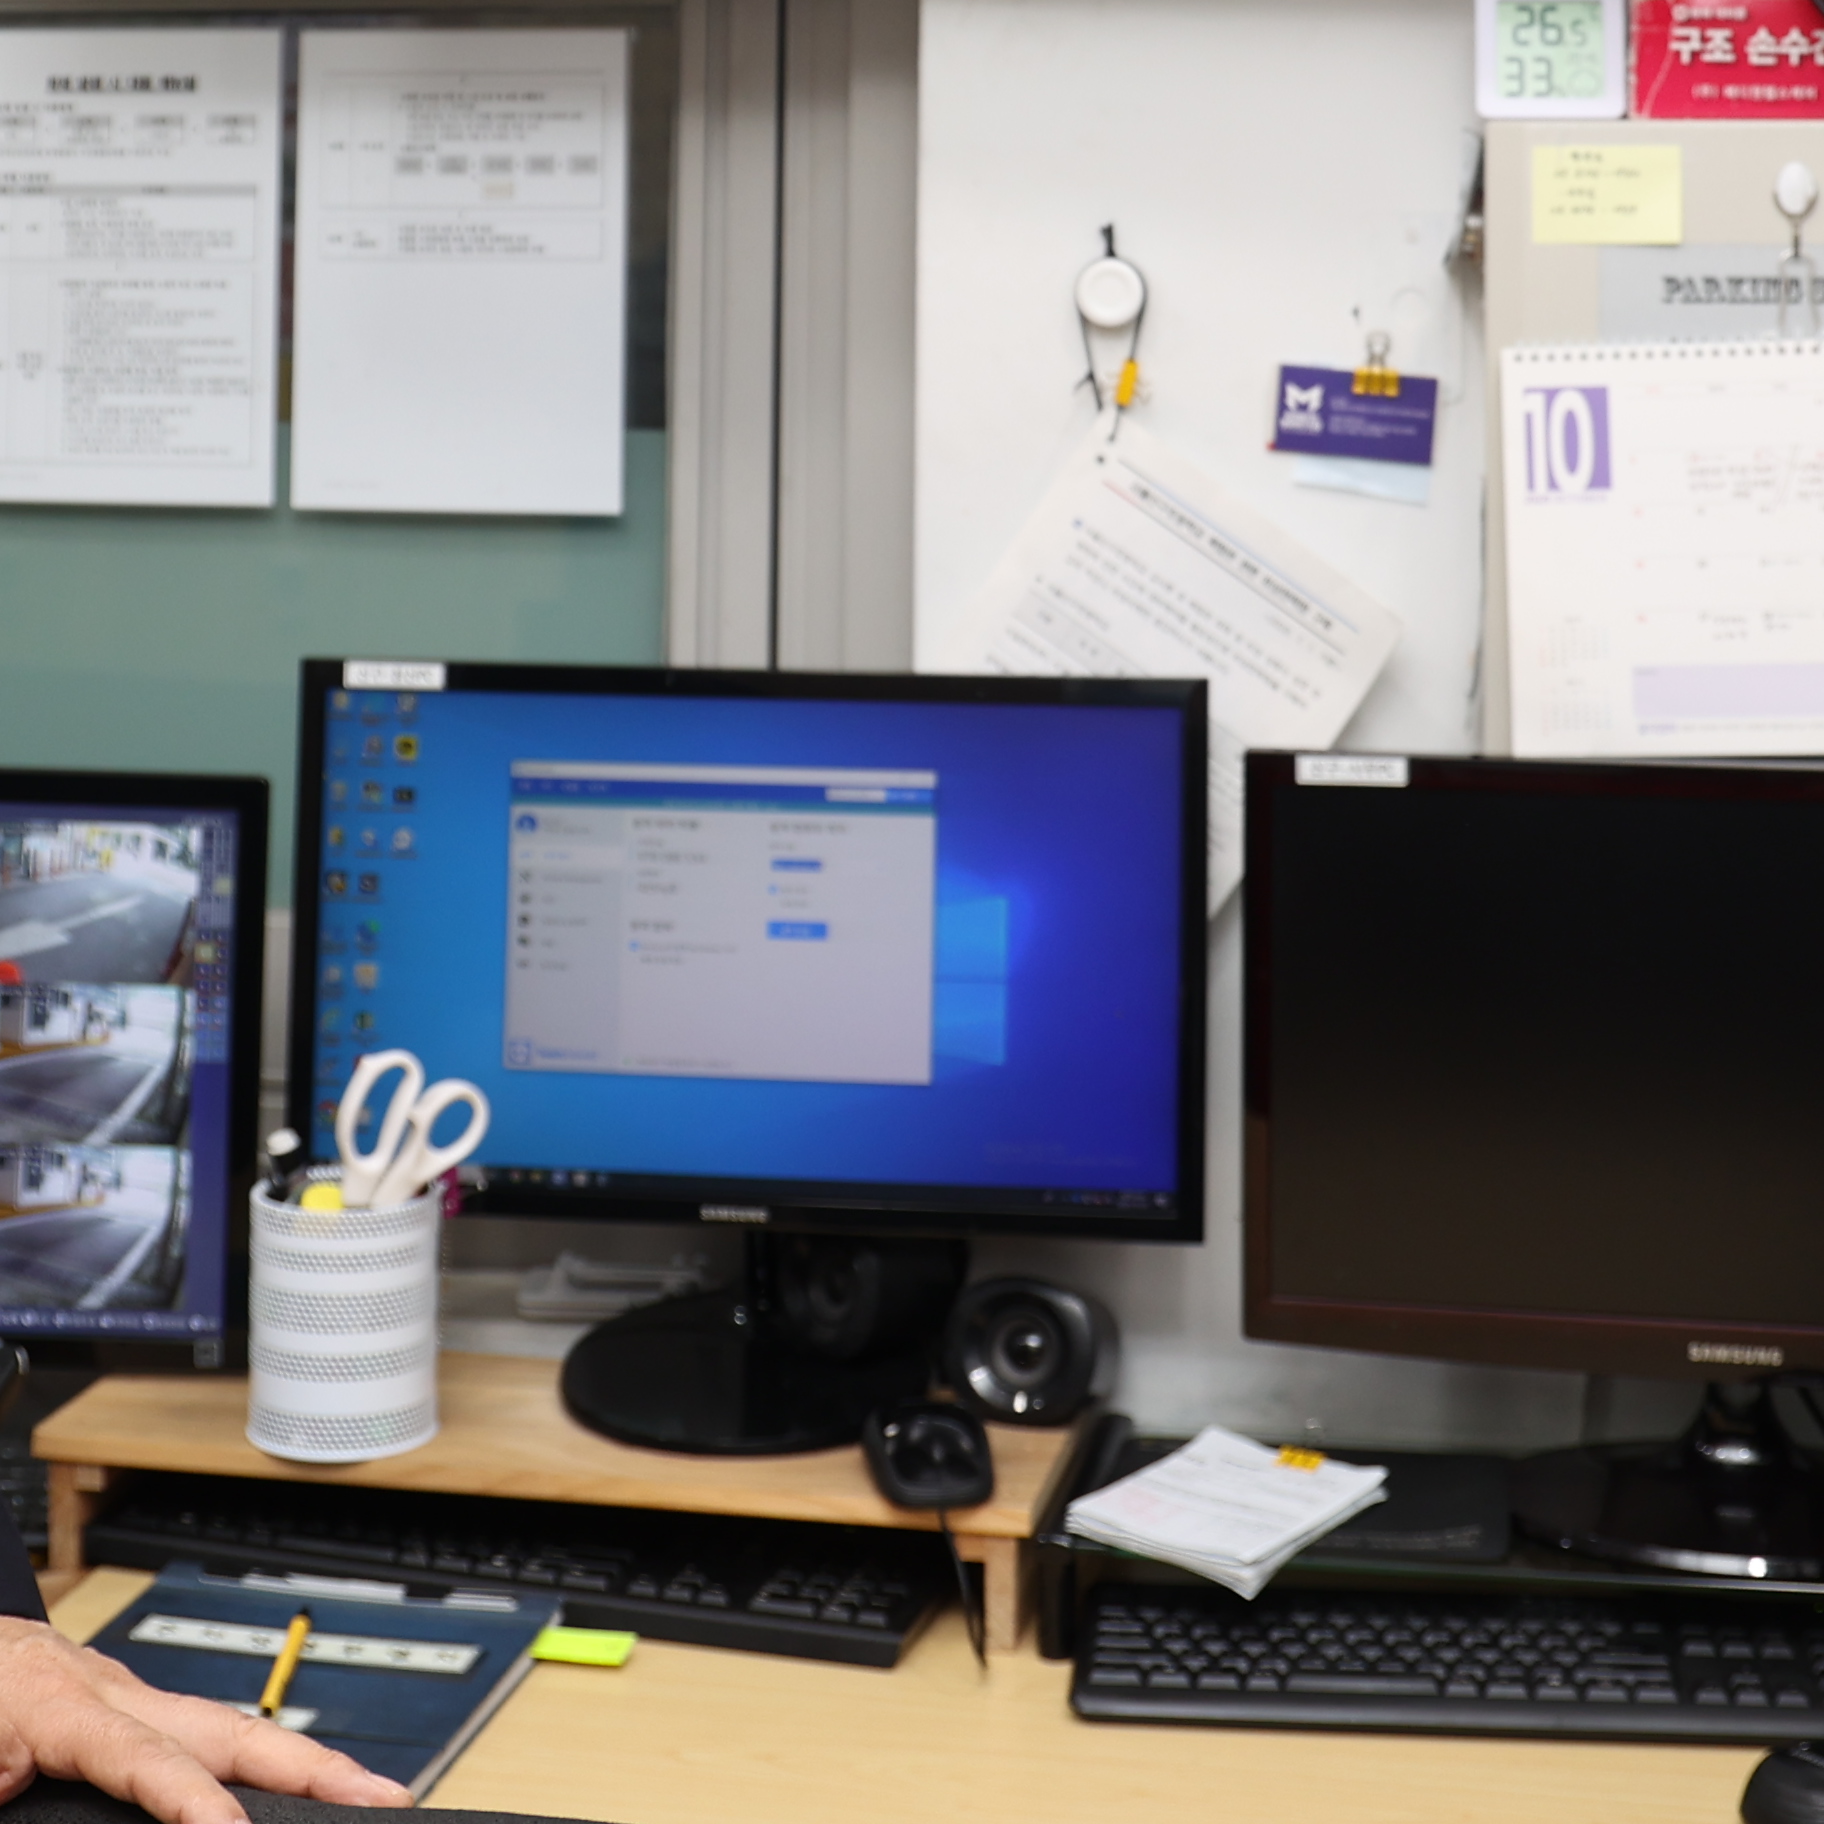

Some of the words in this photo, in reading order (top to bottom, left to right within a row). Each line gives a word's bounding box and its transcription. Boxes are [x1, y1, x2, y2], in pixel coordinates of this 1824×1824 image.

[1669, 26, 1737, 66] 구조
[1662, 277, 1804, 306] PARKING
[1523, 388, 1596, 494] 10
[1687, 1341, 1784, 1366] SAMSUNG
